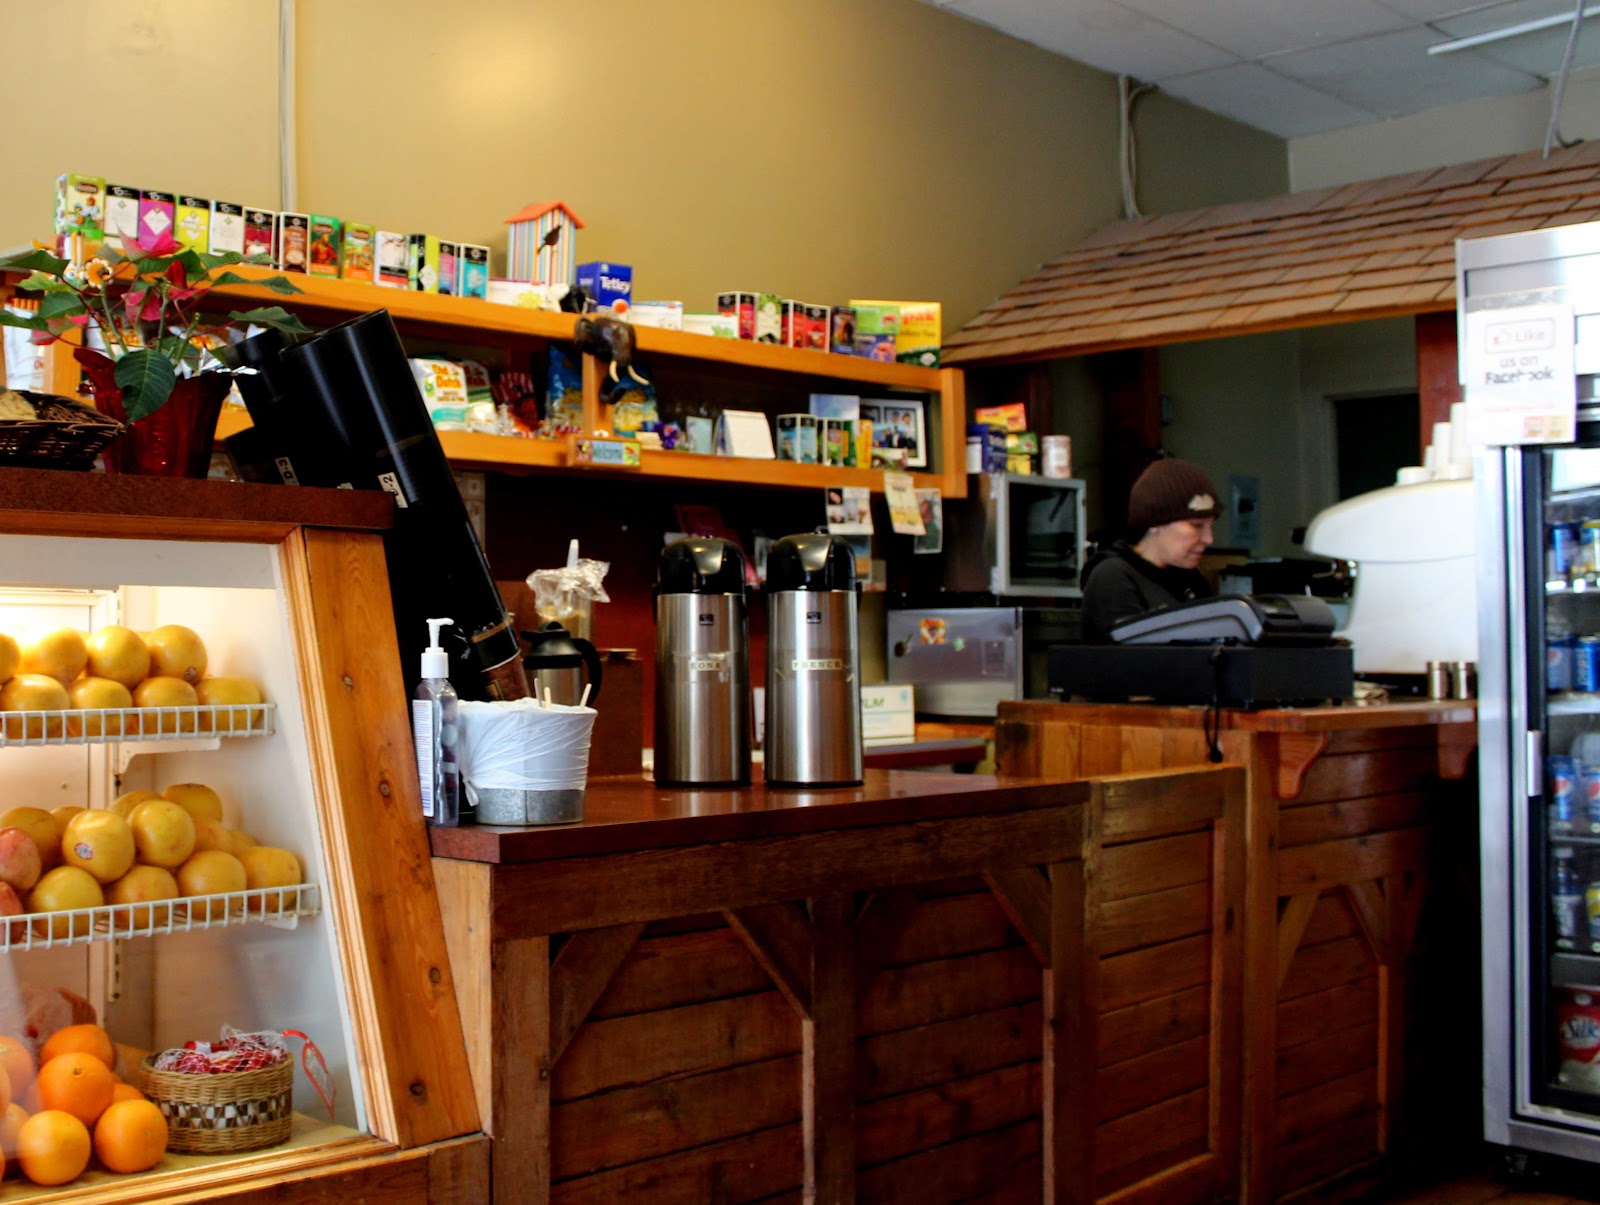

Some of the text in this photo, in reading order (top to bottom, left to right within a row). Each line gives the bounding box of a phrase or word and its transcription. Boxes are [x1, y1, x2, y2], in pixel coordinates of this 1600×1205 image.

[600, 276, 630, 295] Tetley
[1515, 329, 1545, 342] Like
[1500, 355, 1538, 368] us on
[436, 375, 462, 388] Dutch
[691, 661, 721, 670] KONA
[793, 660, 841, 670] FRENCH
